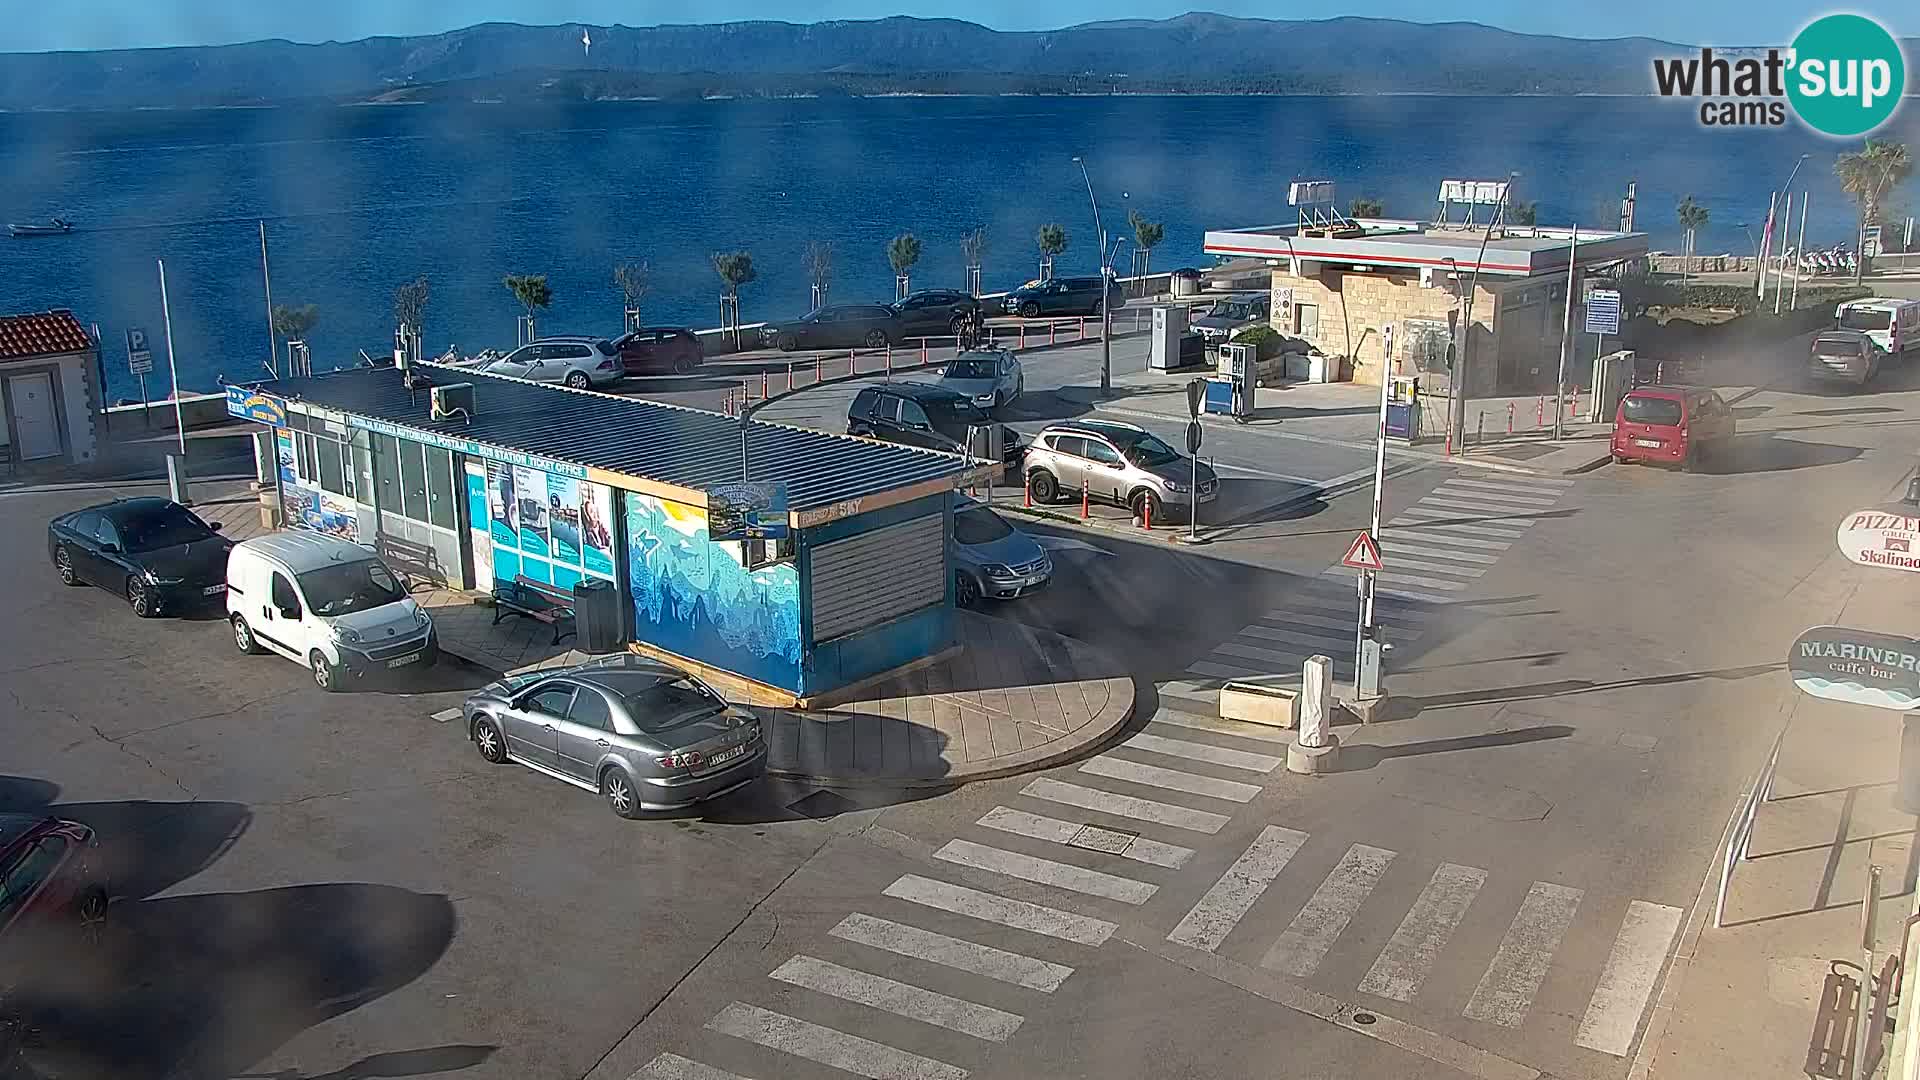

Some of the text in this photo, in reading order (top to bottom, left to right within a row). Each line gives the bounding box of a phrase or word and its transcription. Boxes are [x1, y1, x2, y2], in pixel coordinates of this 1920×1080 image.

[131, 331, 144, 349] P
[479, 445, 494, 458] BUS
[494, 448, 527, 465] STATION
[528, 456, 554, 470] TICKET
[555, 462, 584, 477] OFFICE
[839, 499, 863, 517] SKY
[1848, 515, 1920, 533] PIZZE
[1829, 661, 1896, 680] caffe bar
